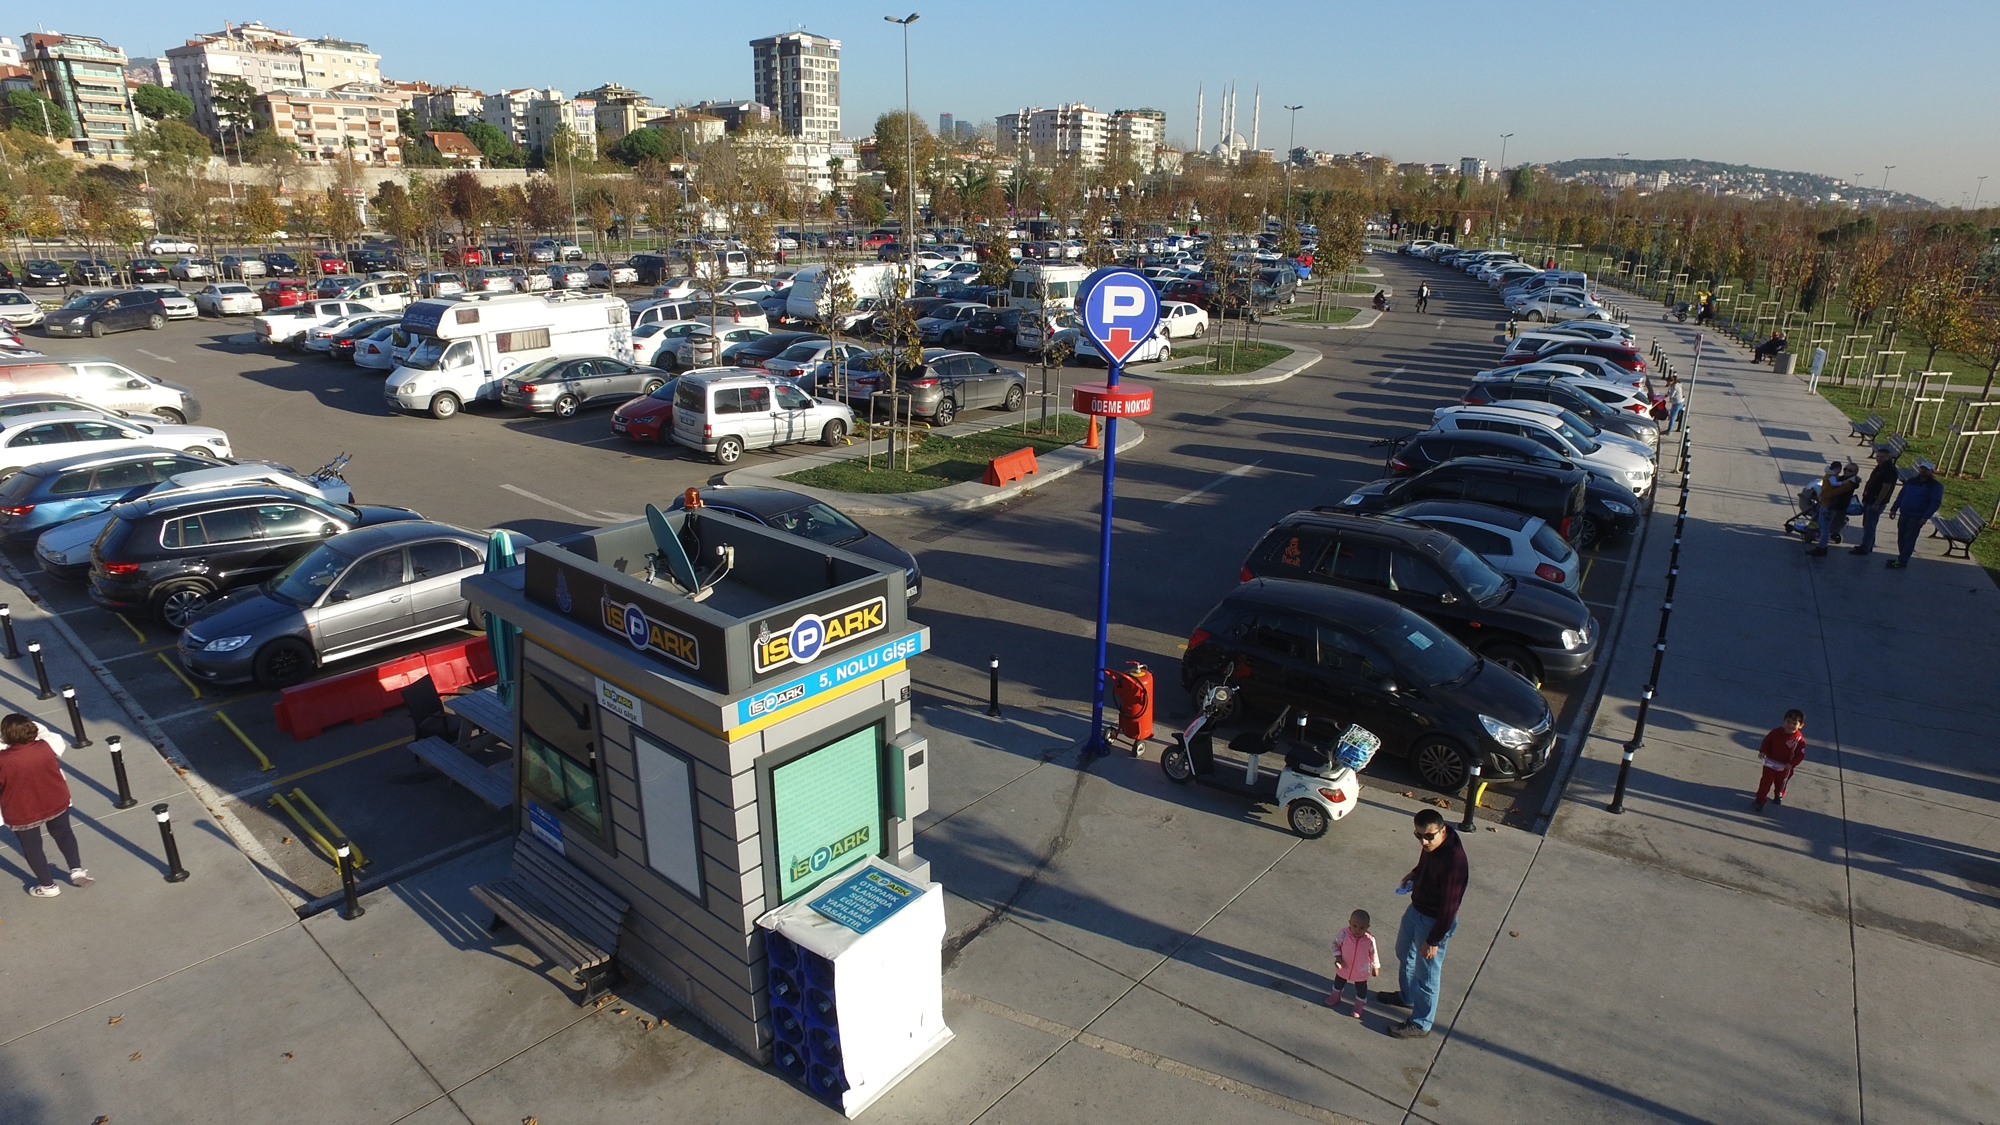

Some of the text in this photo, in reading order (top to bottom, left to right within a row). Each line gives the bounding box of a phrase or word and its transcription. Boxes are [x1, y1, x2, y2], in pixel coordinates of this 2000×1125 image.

[1102, 285, 1146, 324] P
[1091, 396, 1123, 414] ÖDEME
[819, 638, 915, 688] 5, NOLU GİŞE
[848, 892, 879, 910] SÜRÜŞ
[849, 884, 893, 909] ALANINDA
[859, 880, 900, 903] OTOPARK
[820, 903, 863, 928] YASAKTIR
[826, 897, 873, 924] YAPILMASI
